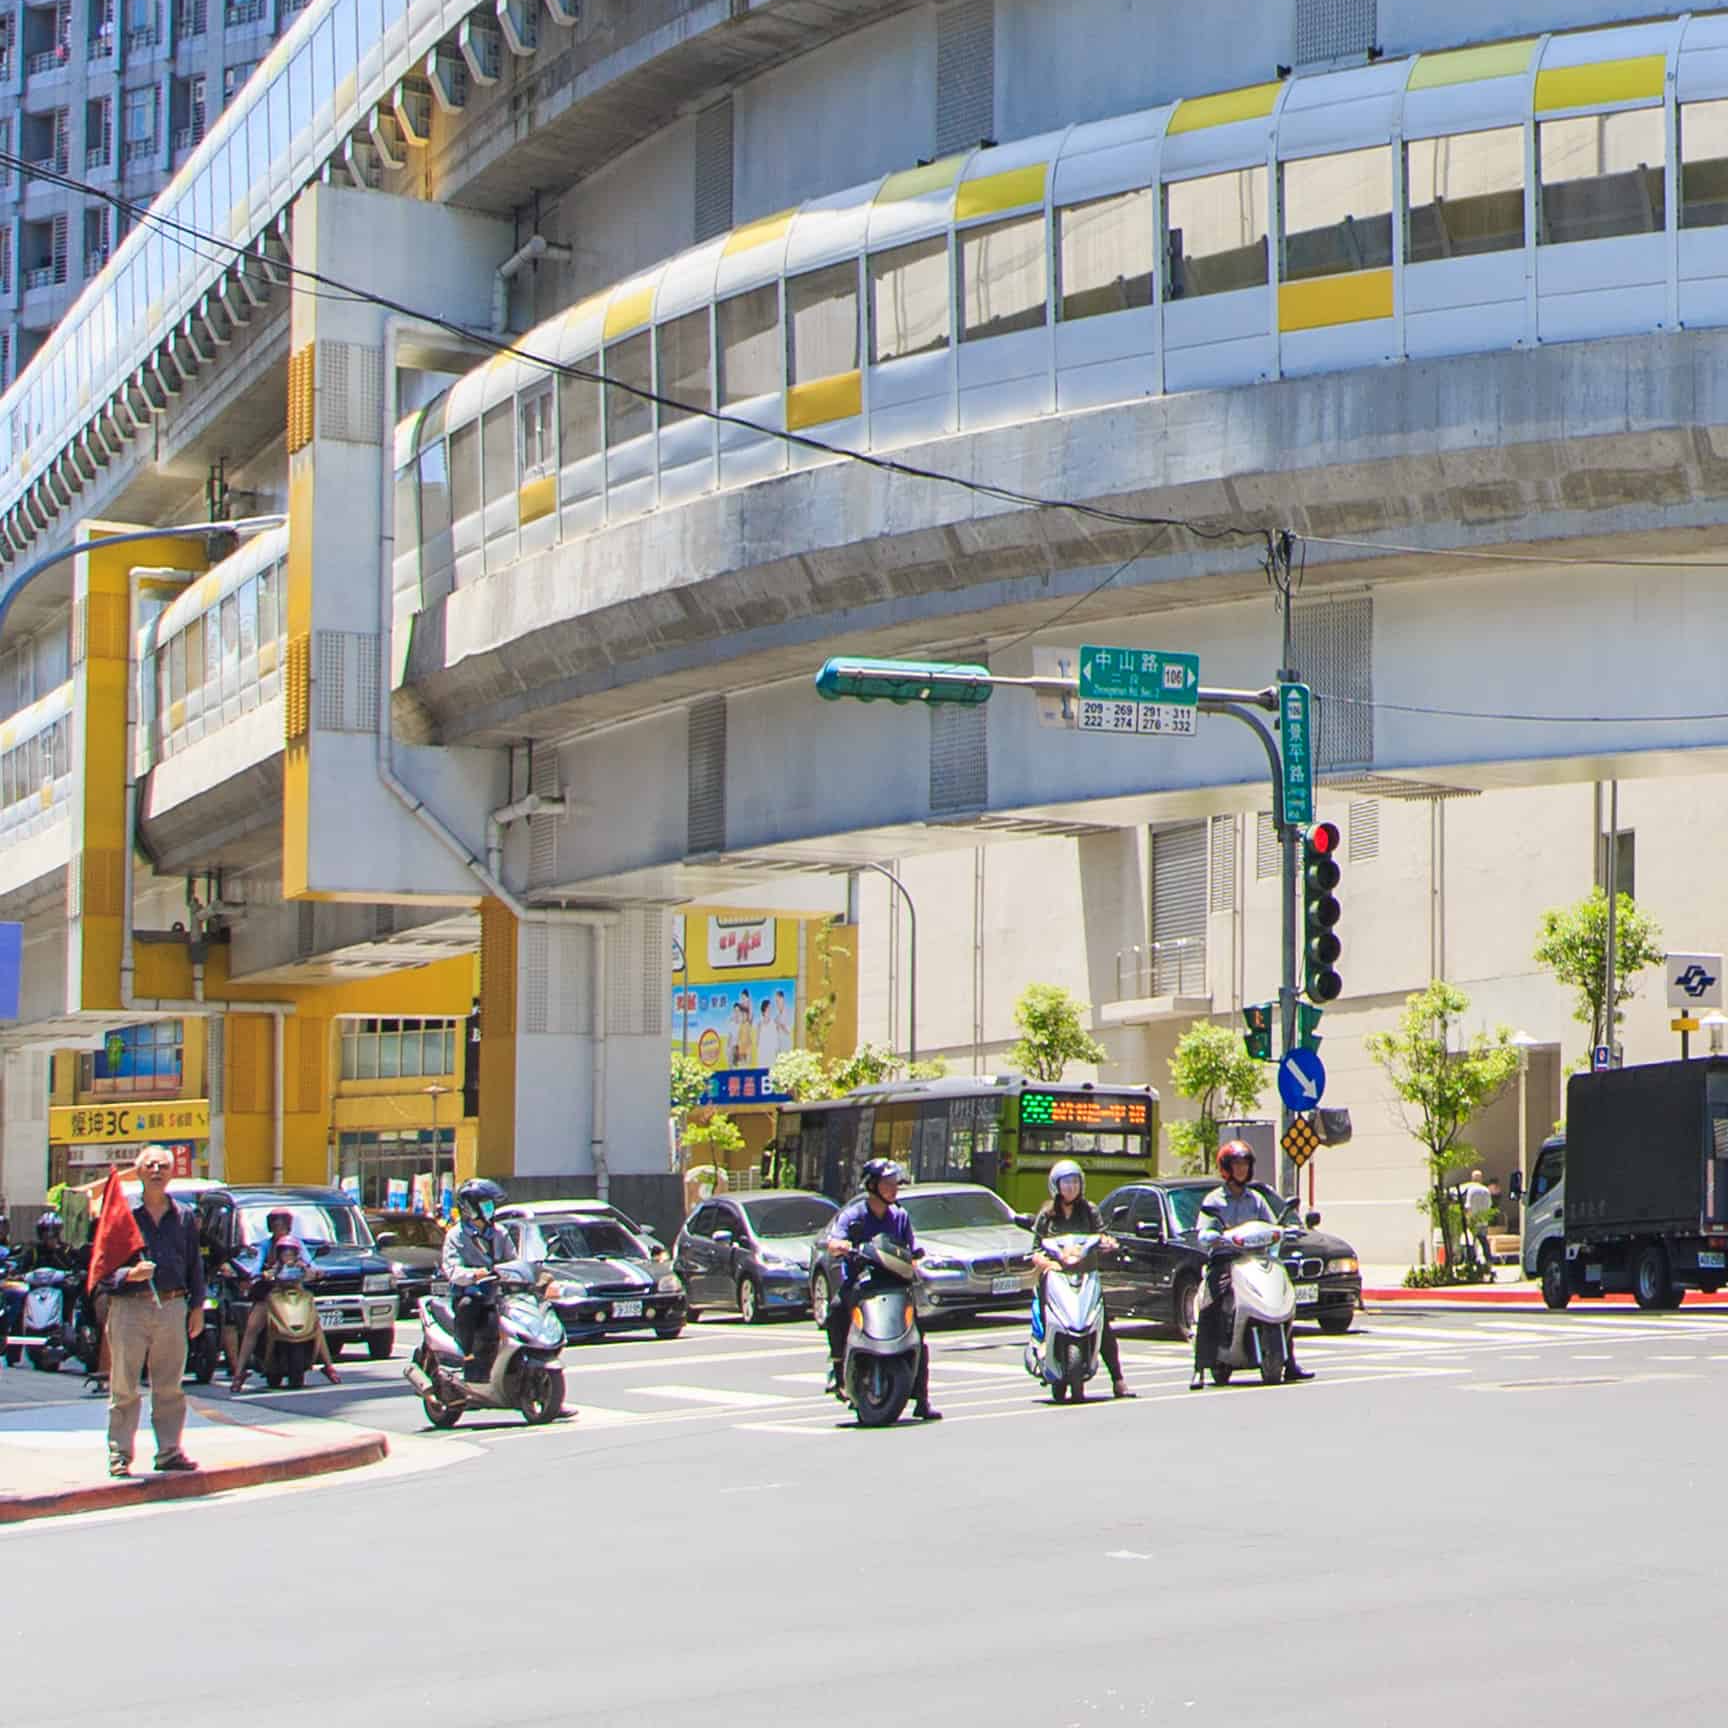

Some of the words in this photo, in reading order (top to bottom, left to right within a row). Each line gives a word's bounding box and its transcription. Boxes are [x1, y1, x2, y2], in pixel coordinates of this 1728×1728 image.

[1096, 650, 1158, 673] 中山路
[1166, 668, 1182, 685] 106
[1114, 718, 1132, 728] 274
